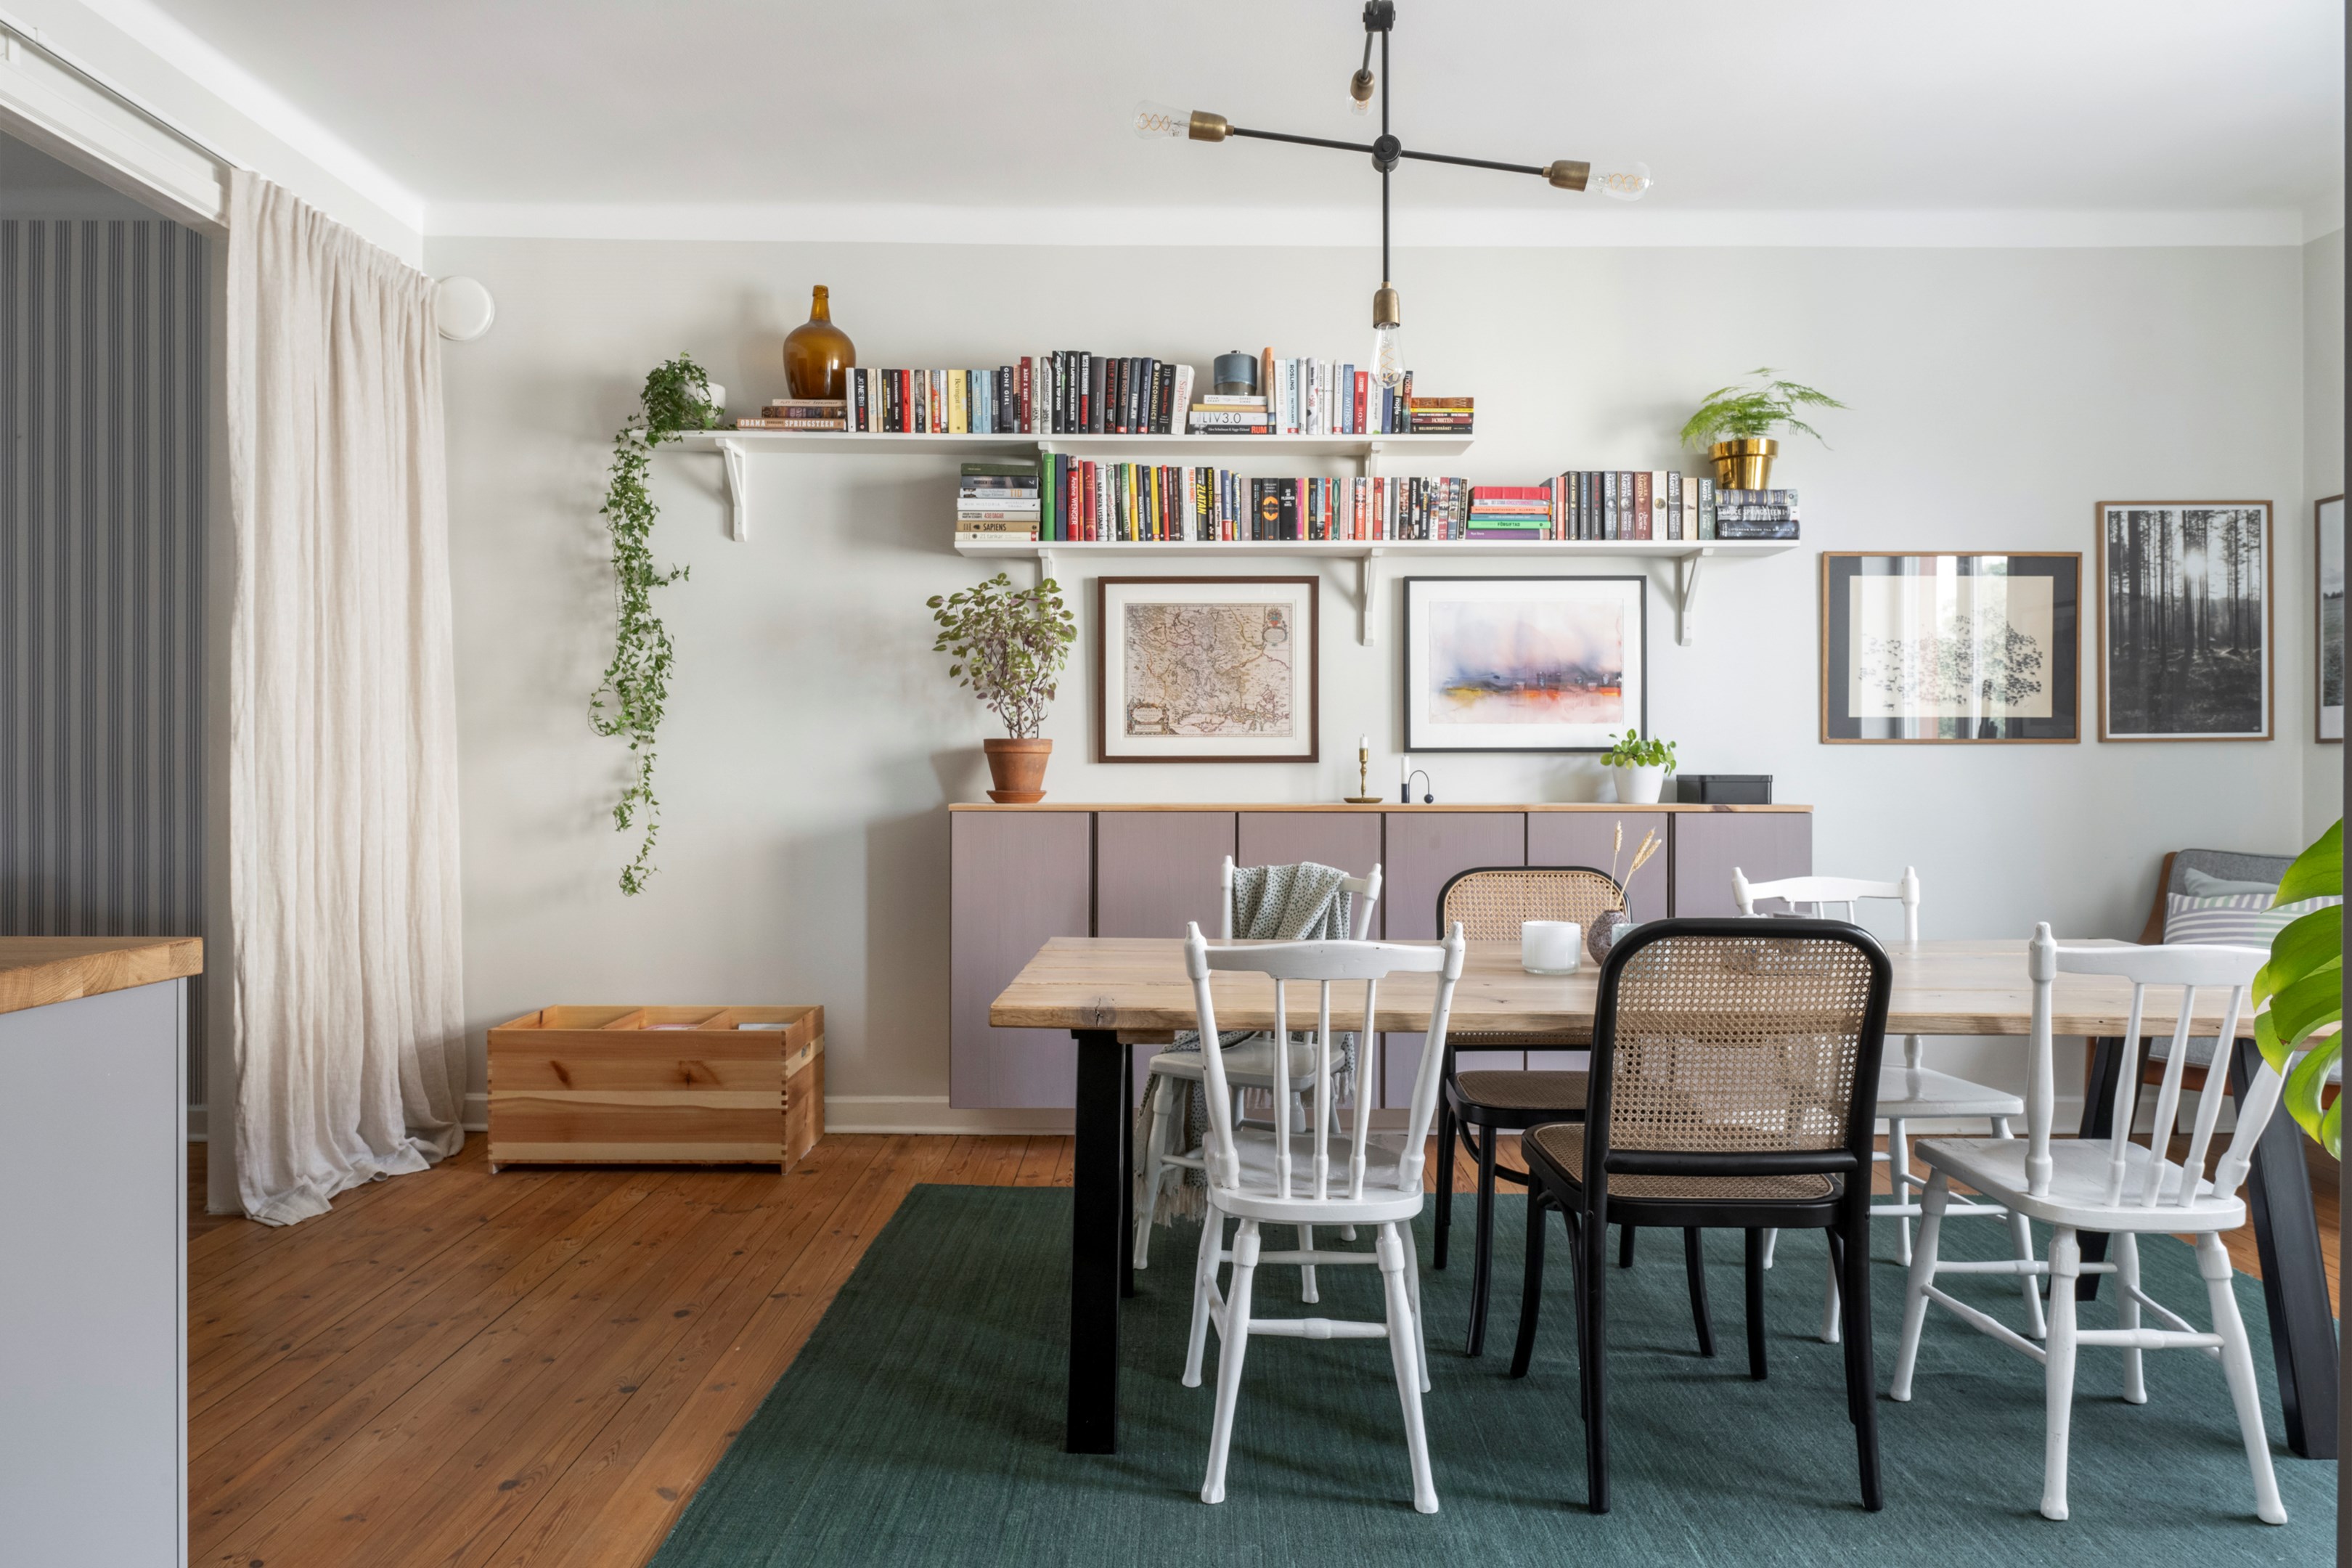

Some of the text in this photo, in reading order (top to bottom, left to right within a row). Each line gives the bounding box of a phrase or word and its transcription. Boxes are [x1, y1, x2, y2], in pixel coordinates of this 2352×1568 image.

[1151, 372, 1159, 420] NARCONOMICS
[1177, 380, 1188, 412] Sapiens
[1251, 425, 1267, 434] RUM
[1010, 489, 1022, 497] TID
[1197, 483, 1206, 515] ZLATAN
